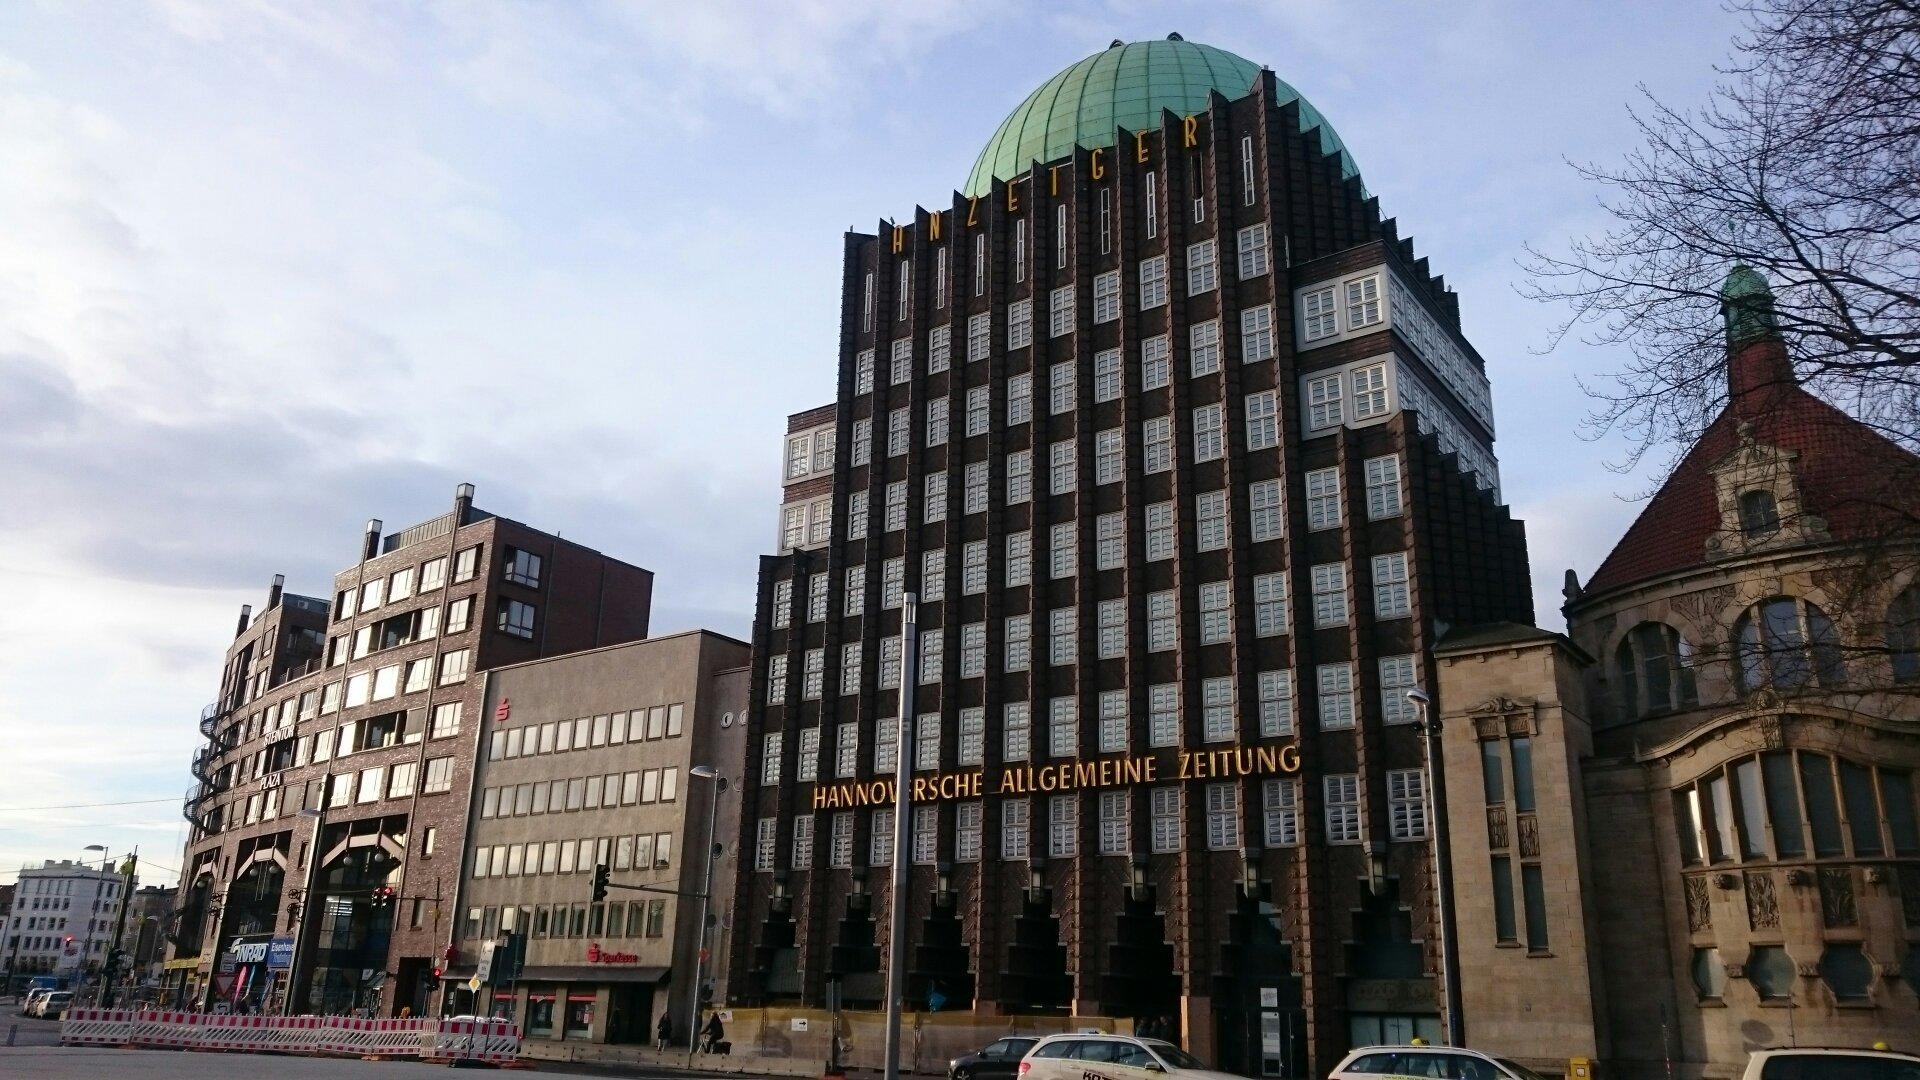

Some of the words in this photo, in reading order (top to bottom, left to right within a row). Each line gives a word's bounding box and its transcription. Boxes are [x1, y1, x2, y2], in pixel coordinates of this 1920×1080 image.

[264, 724, 295, 747] STEINTOR
[260, 772, 281, 791] PLAZA
[813, 772, 983, 809] HANNOVRSCHE
[1000, 756, 1156, 793] ALLGEMEINE
[1178, 745, 1300, 779] ZEITUNG
